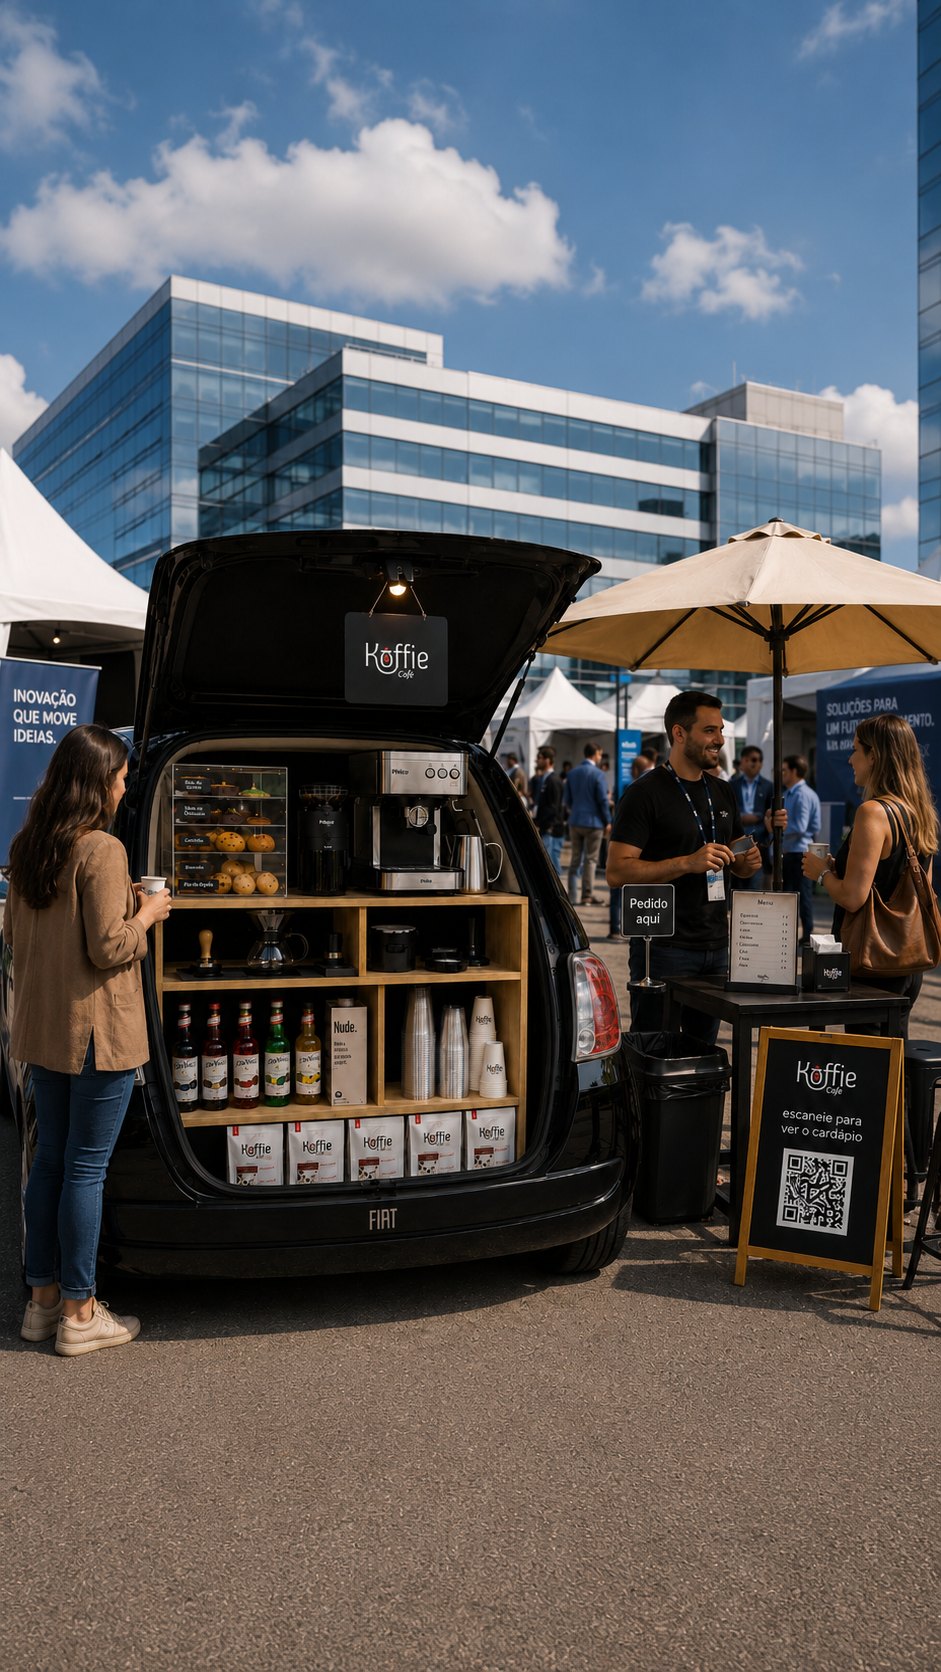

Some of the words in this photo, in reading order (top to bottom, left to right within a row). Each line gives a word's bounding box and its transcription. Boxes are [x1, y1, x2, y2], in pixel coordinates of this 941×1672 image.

[13, 688, 77, 709] INOVAÇÃO
[826, 697, 872, 717] SOLUÇÕES
[873, 696, 898, 712] PARA
[13, 709, 40, 725] QUE
[42, 711, 77, 726] MOVE
[13, 729, 57, 744] IDEIAS.
[825, 721, 840, 736] UM
[630, 898, 668, 909] Pedido
[636, 912, 661, 926] aqui
[333, 1020, 357, 1034] Nude.
[782, 1109, 833, 1123] escaneie
[835, 1115, 862, 1127] para
[781, 1124, 799, 1135] ver
[801, 1127, 810, 1136] o
[812, 1127, 863, 1143] cardápio
[368, 1208, 398, 1231] FIAT
